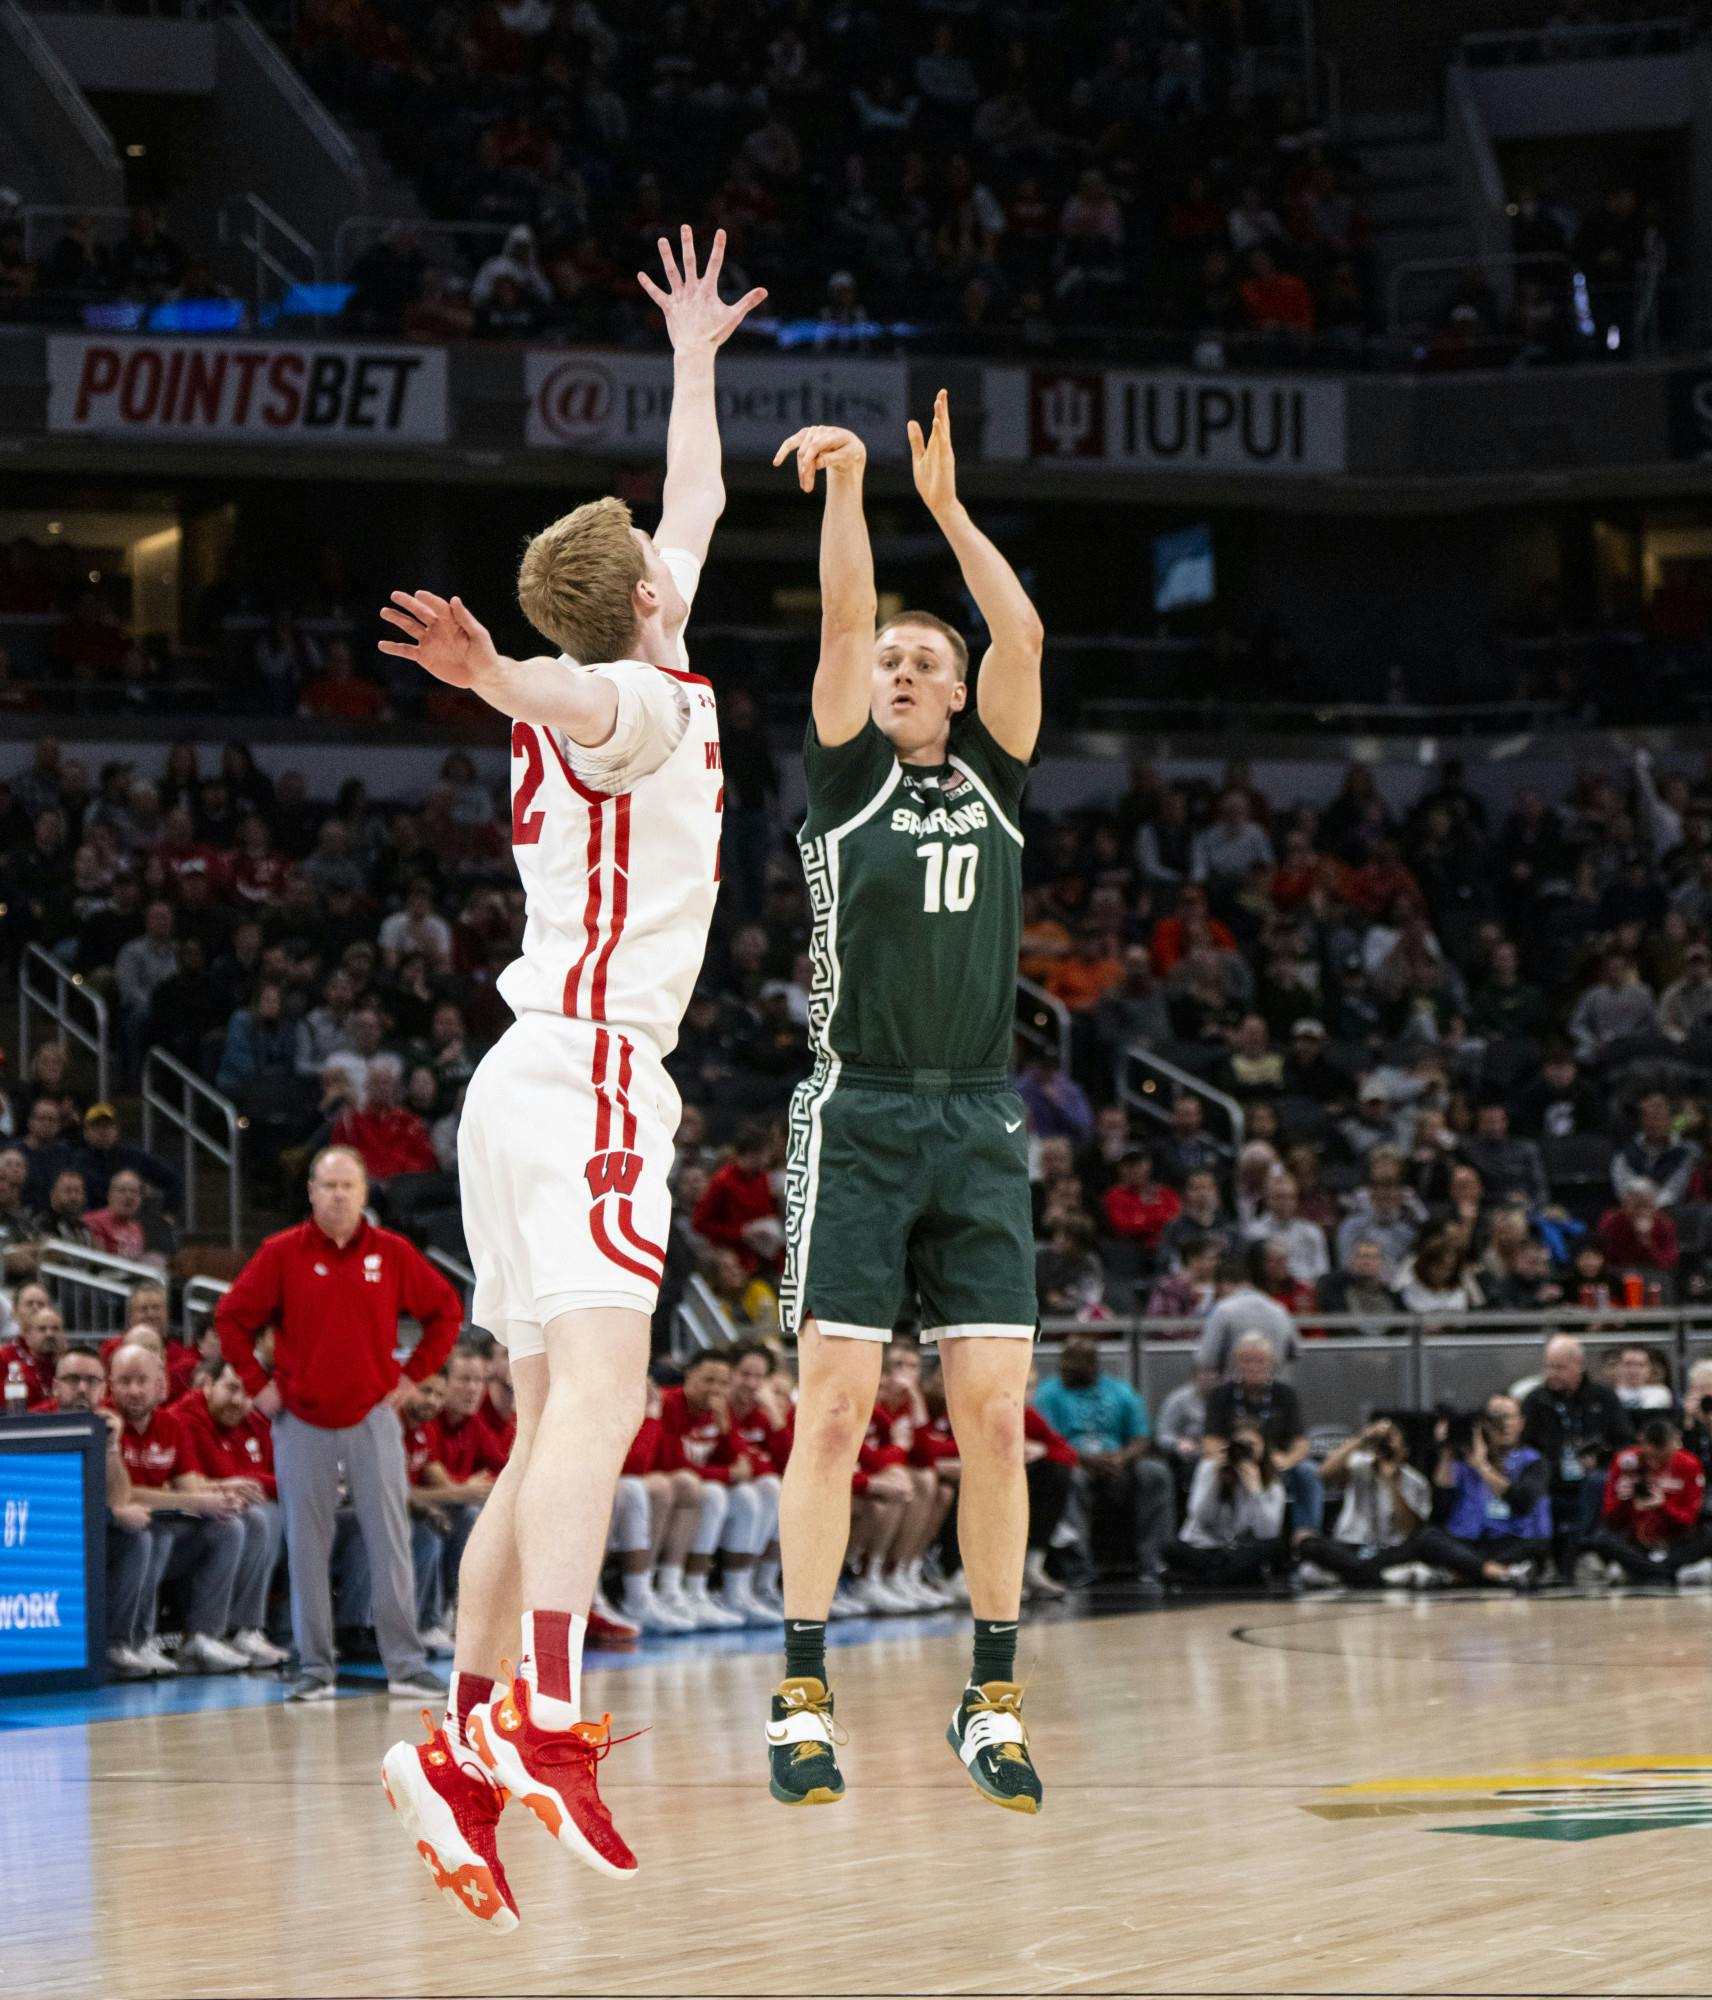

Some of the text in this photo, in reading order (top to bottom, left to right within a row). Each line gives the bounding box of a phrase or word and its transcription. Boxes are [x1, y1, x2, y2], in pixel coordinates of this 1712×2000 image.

[75, 346, 423, 430] POINTSBET
[1123, 382, 1304, 463] IUPUI
[890, 800, 988, 840] SPARANS
[916, 842, 979, 913] 10
[584, 1150, 644, 1201] W
[4, 1499, 29, 1549] BY
